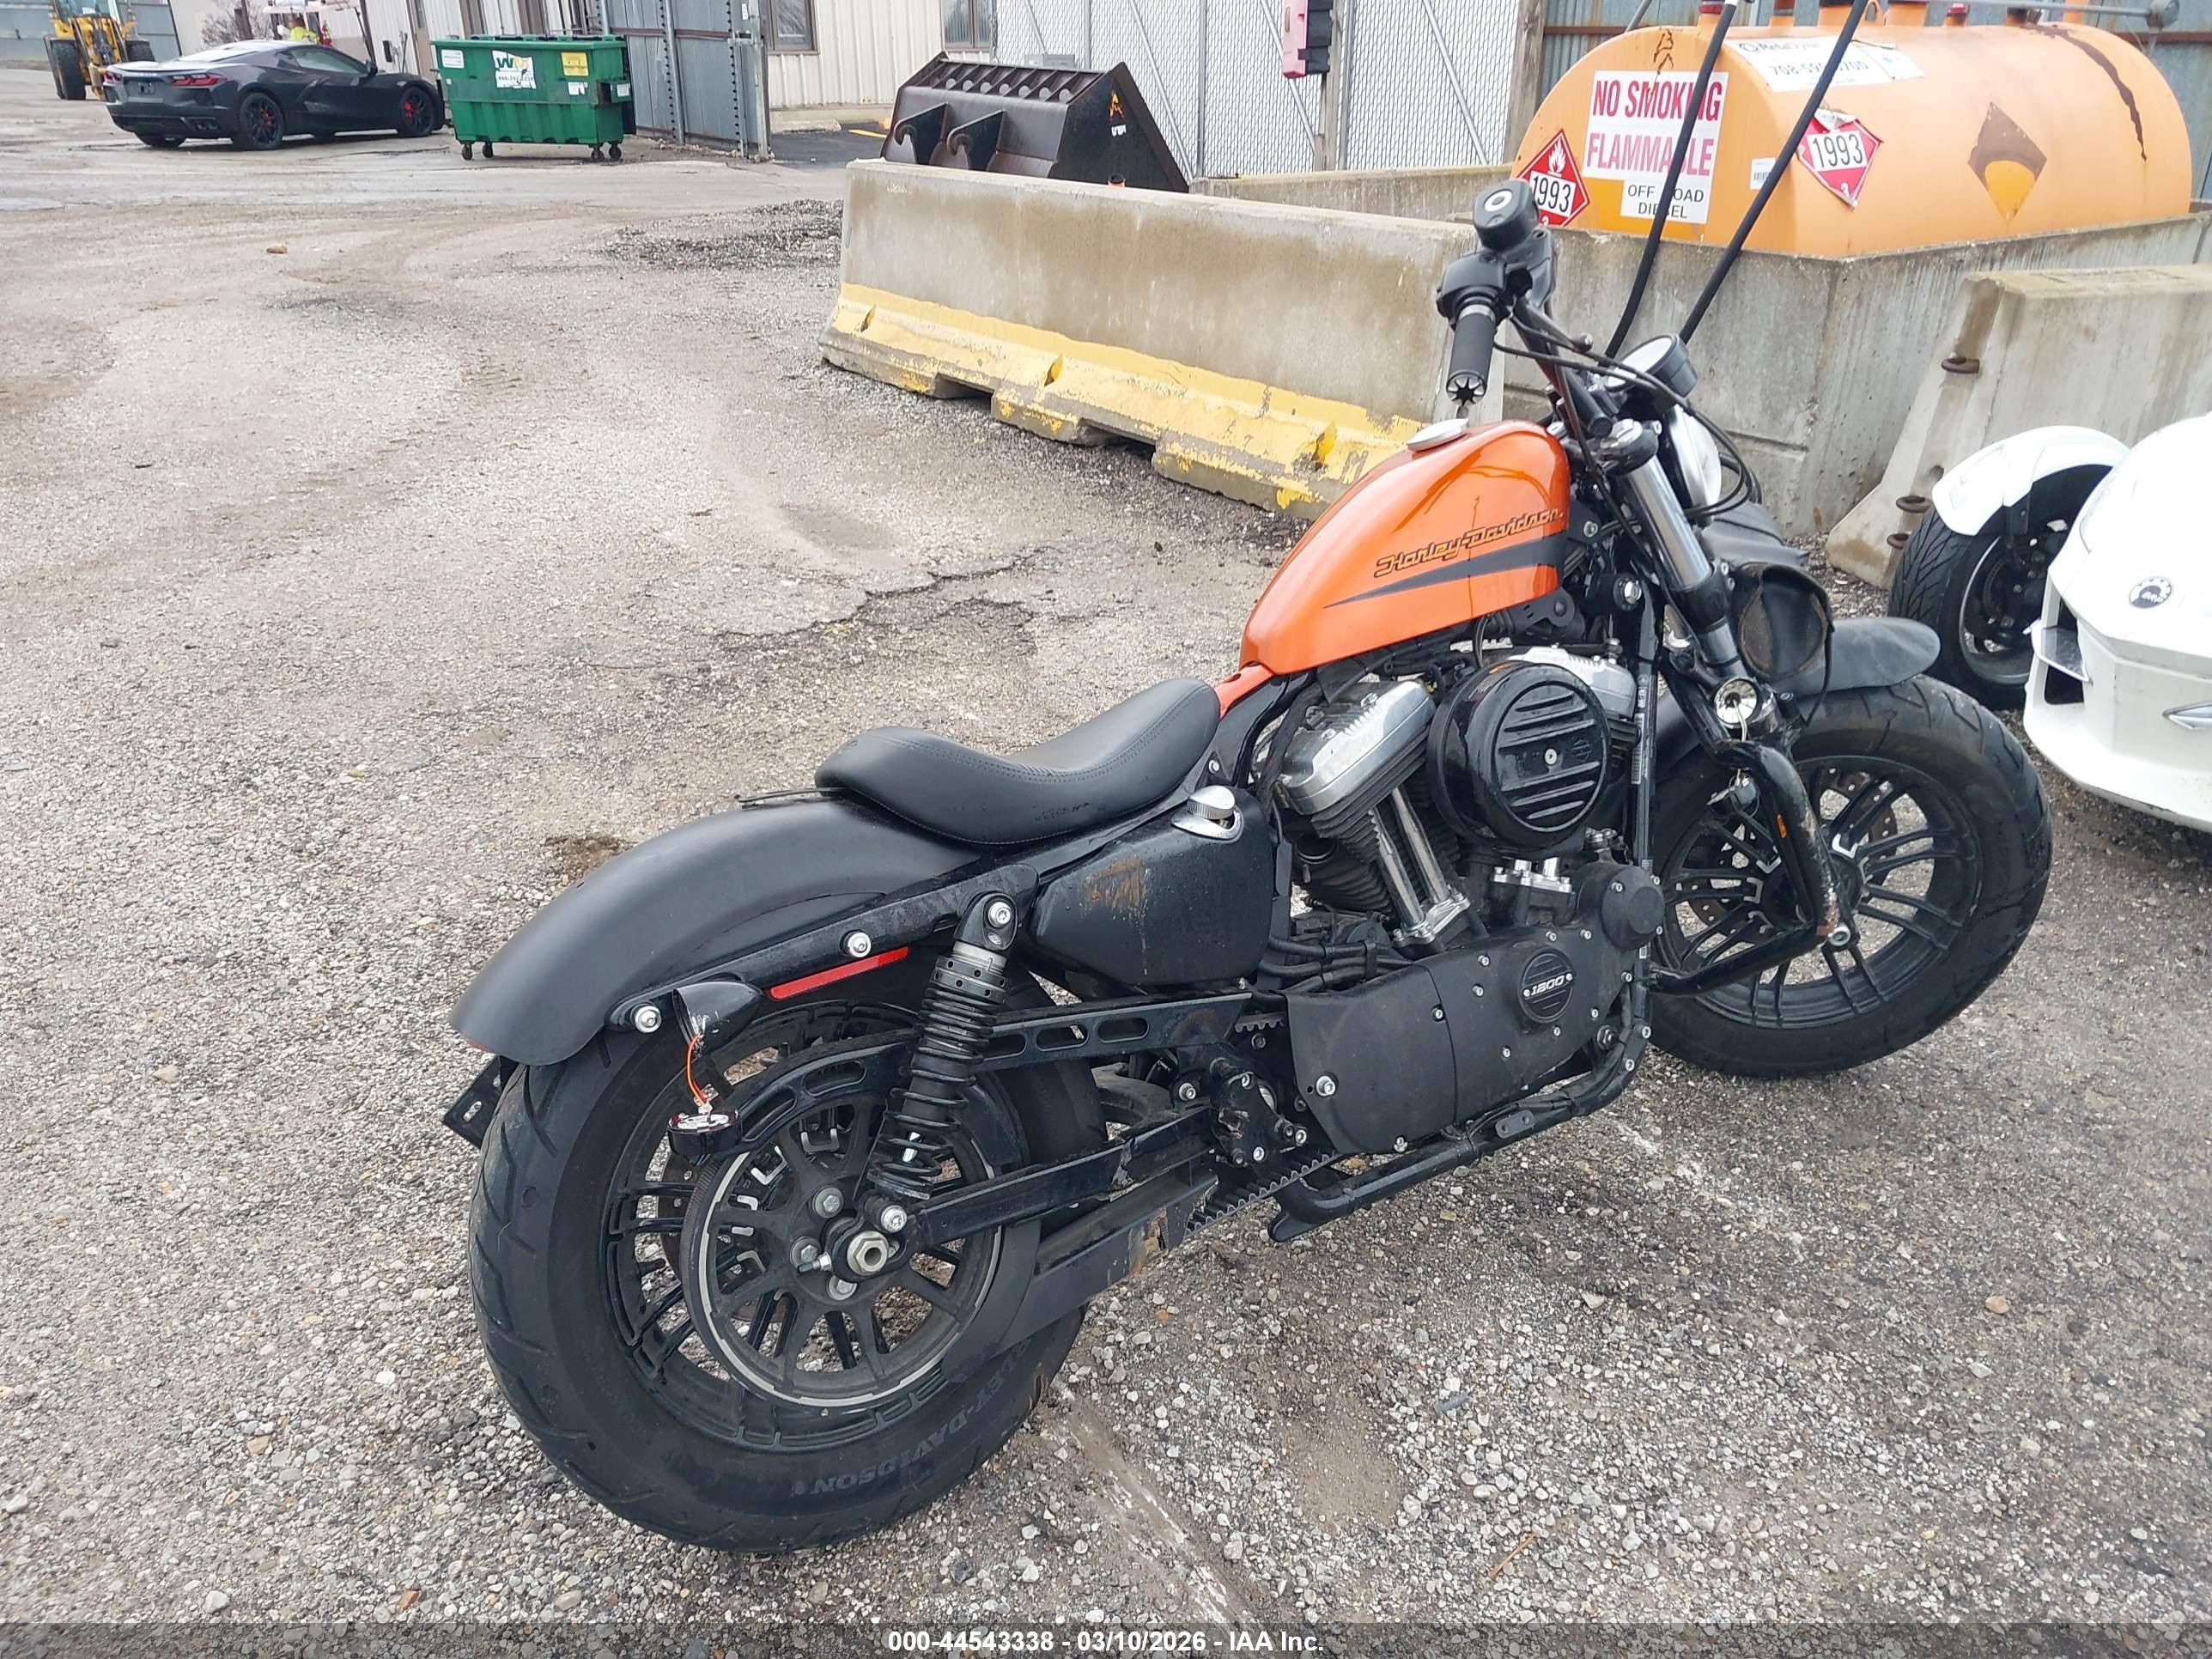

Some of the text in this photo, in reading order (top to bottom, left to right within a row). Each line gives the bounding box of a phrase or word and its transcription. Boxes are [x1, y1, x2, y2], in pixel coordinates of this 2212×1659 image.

[1593, 80, 1620, 117] NO
[1587, 133, 1714, 176] FLAMMALE
[1813, 134, 1863, 167] 1993
[1533, 175, 1571, 212] 1993
[1627, 184, 1705, 203] OFF OAD
[1638, 202, 1687, 218] DIEEL
[1530, 975, 1565, 996] 1200
